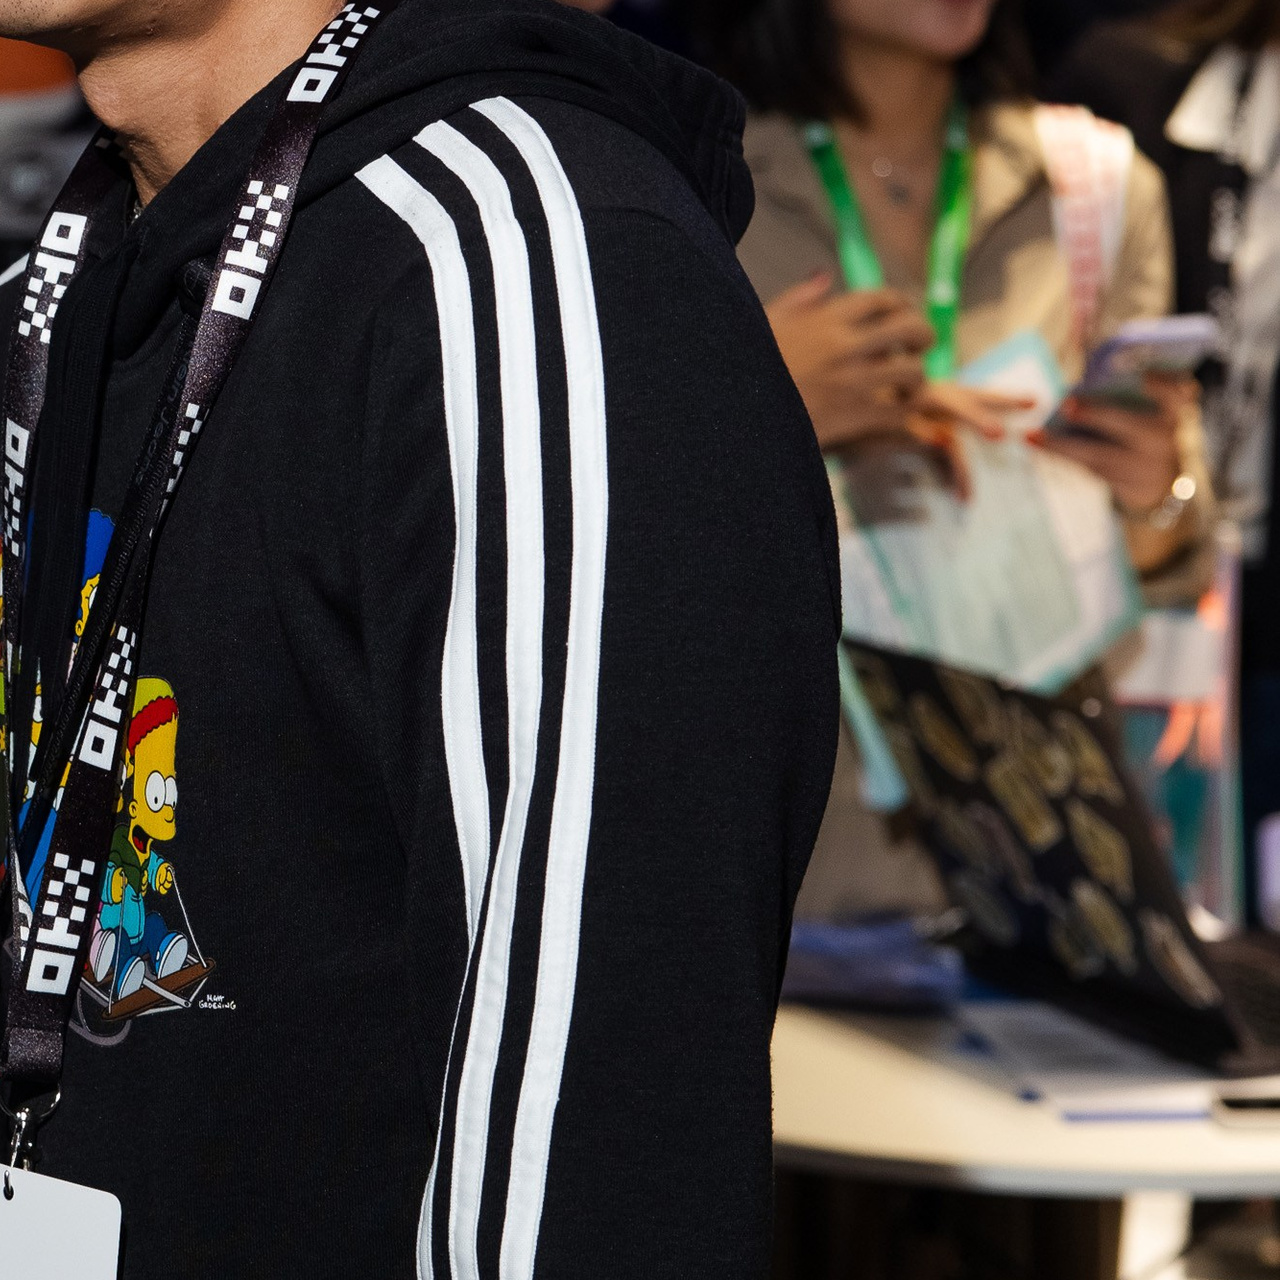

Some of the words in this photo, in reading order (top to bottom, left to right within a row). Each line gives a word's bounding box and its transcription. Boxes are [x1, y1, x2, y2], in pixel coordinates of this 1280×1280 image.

[286, 3, 380, 103] OKX
[212, 180, 289, 320] OKX
[78, 625, 137, 771] OKX
[26, 851, 96, 996] OKX
